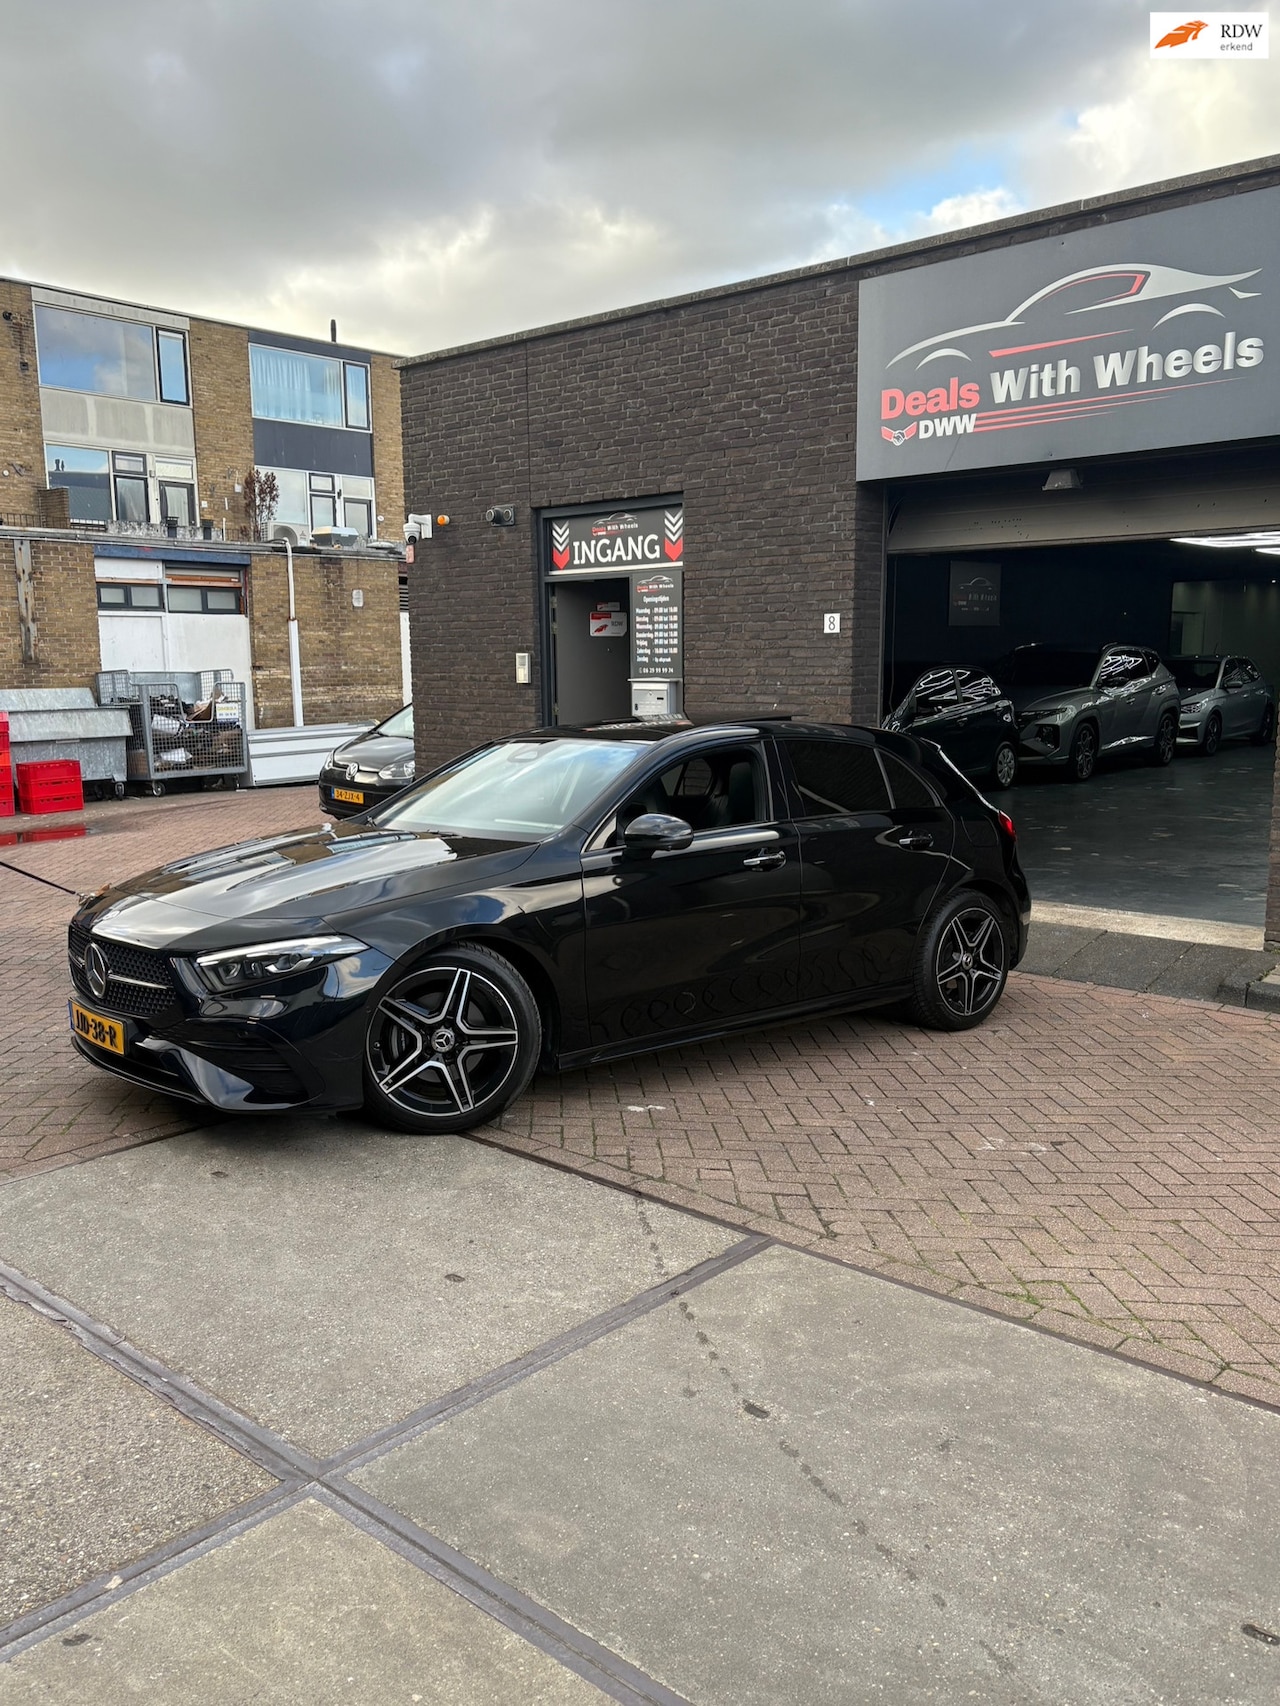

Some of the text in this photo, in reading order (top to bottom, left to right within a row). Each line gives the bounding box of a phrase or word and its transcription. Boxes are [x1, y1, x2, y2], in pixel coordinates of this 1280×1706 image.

[880, 331, 1265, 421] Deals With Wheels
[918, 412, 977, 440] DWW
[620, 522, 639, 530] Wheels
[573, 534, 660, 565] INGANG
[828, 615, 836, 631] 8
